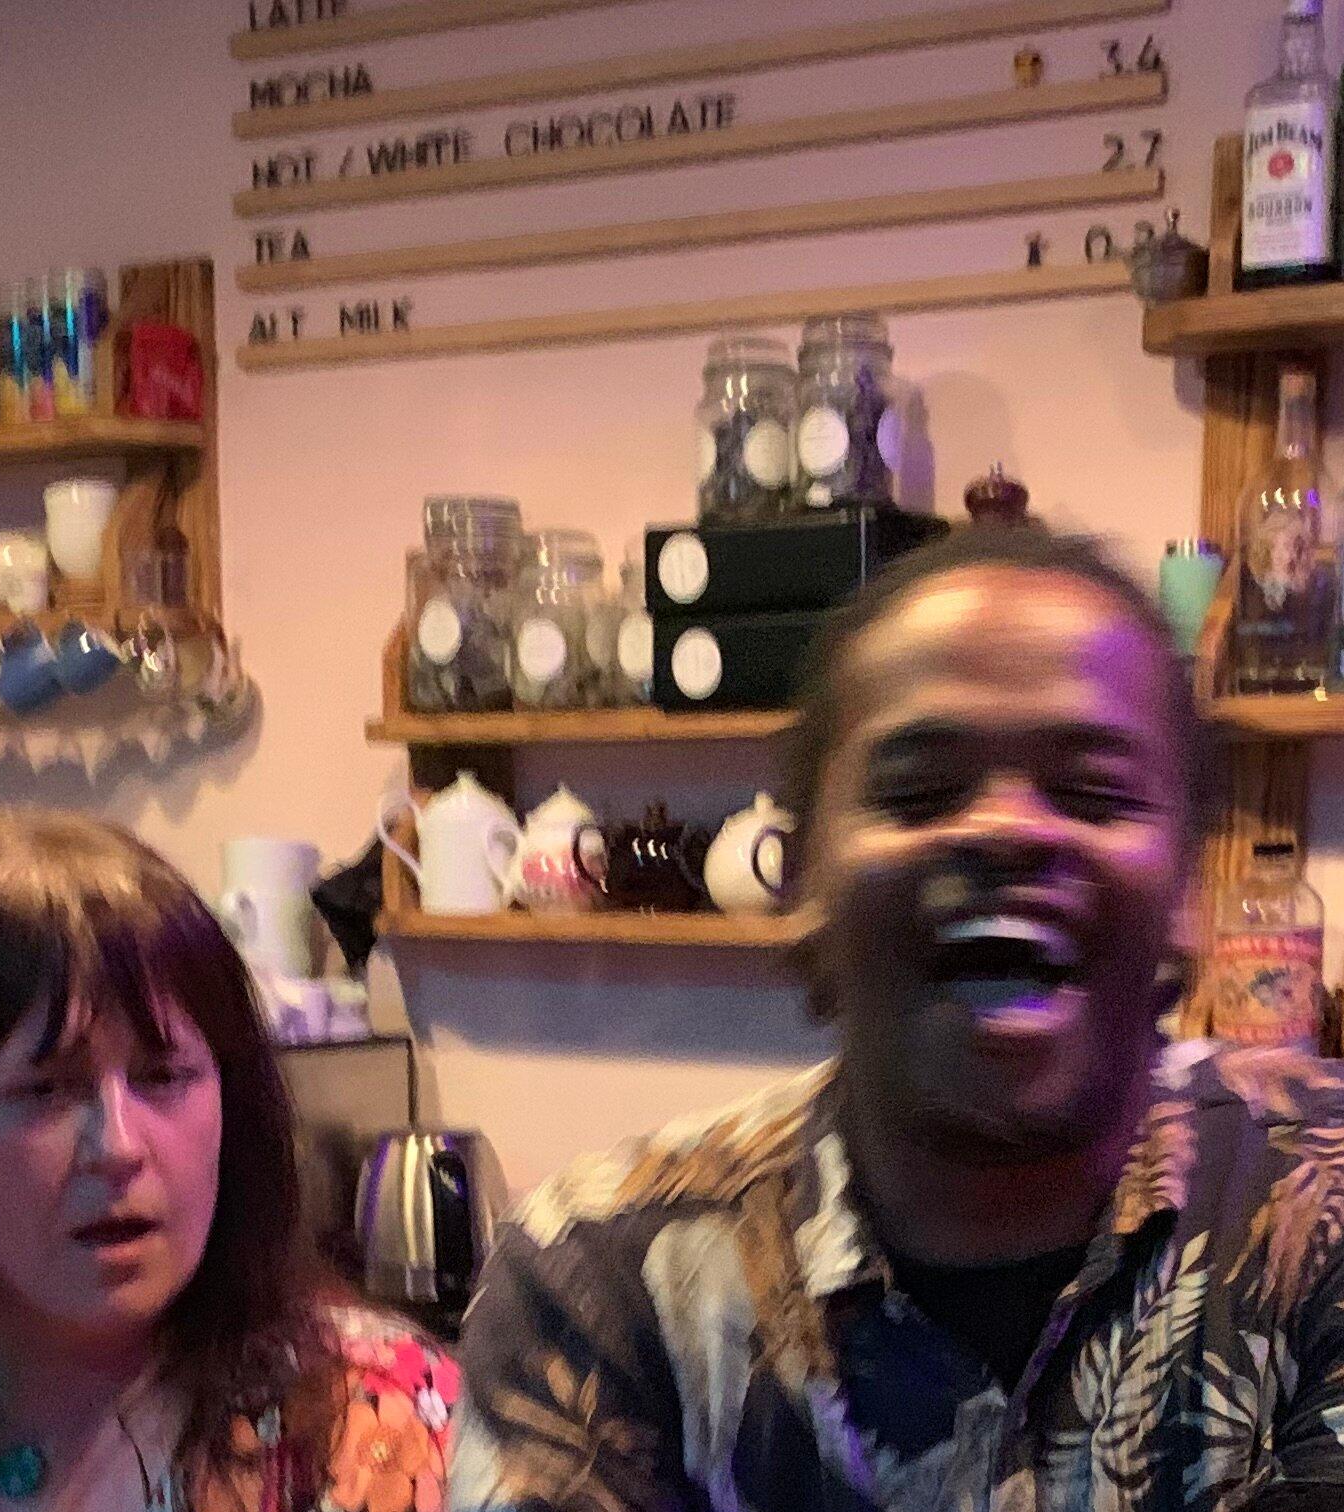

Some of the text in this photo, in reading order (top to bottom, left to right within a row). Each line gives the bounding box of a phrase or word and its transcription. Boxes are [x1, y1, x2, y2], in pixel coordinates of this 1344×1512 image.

[250, 62, 373, 110] MOCHA
[252, 148, 316, 189] HOT
[366, 125, 476, 177] WHITE
[504, 91, 737, 157] CHOCOLATE
[254, 127, 1162, 265] TEA 2.7
[249, 305, 305, 344] ALT
[339, 294, 413, 337] MILK
